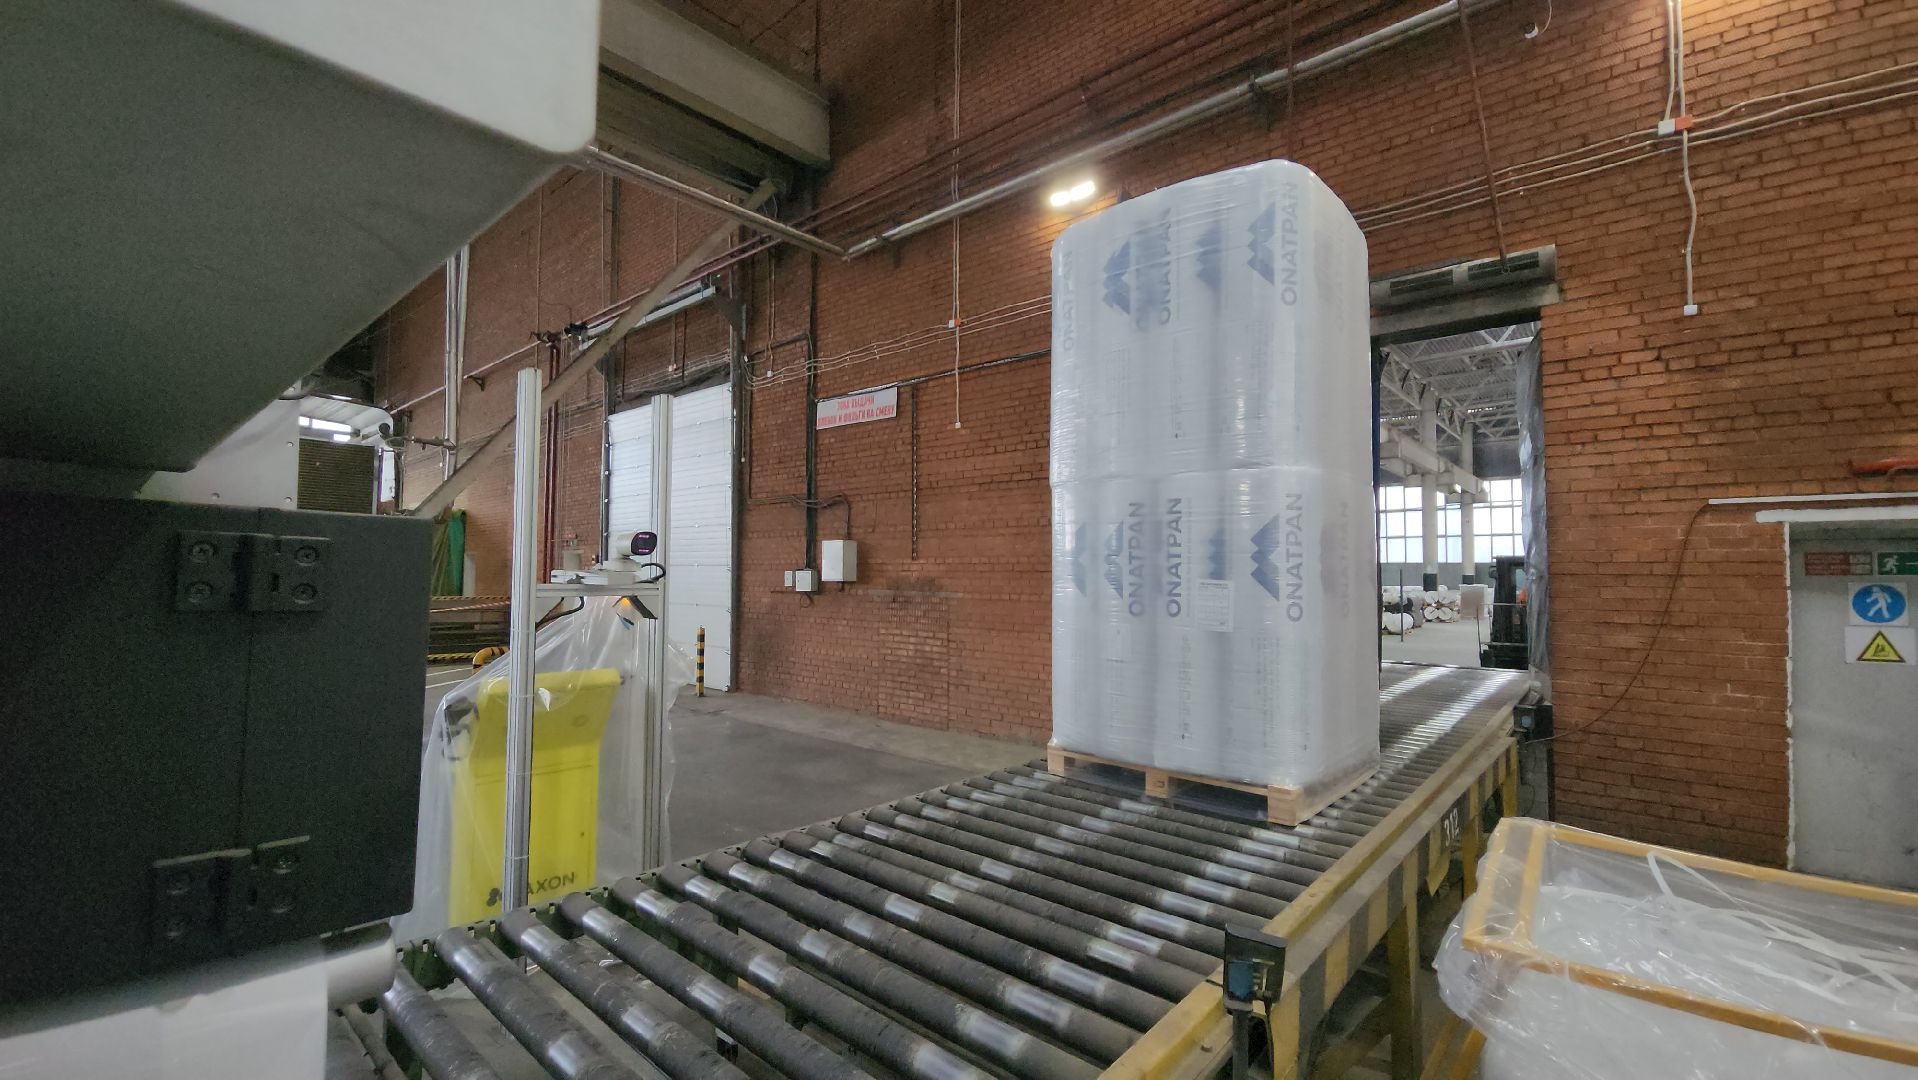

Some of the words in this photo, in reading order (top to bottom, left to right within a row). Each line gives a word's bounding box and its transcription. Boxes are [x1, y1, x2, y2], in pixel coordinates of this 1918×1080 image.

[1282, 181, 1298, 306] ONATPAN
[1128, 502, 1145, 617] ONATPAN
[1166, 498, 1182, 618] ONATPAN
[1286, 493, 1304, 622] ONATPAN
[527, 871, 575, 895] AXON
[1444, 808, 1459, 847] 312
